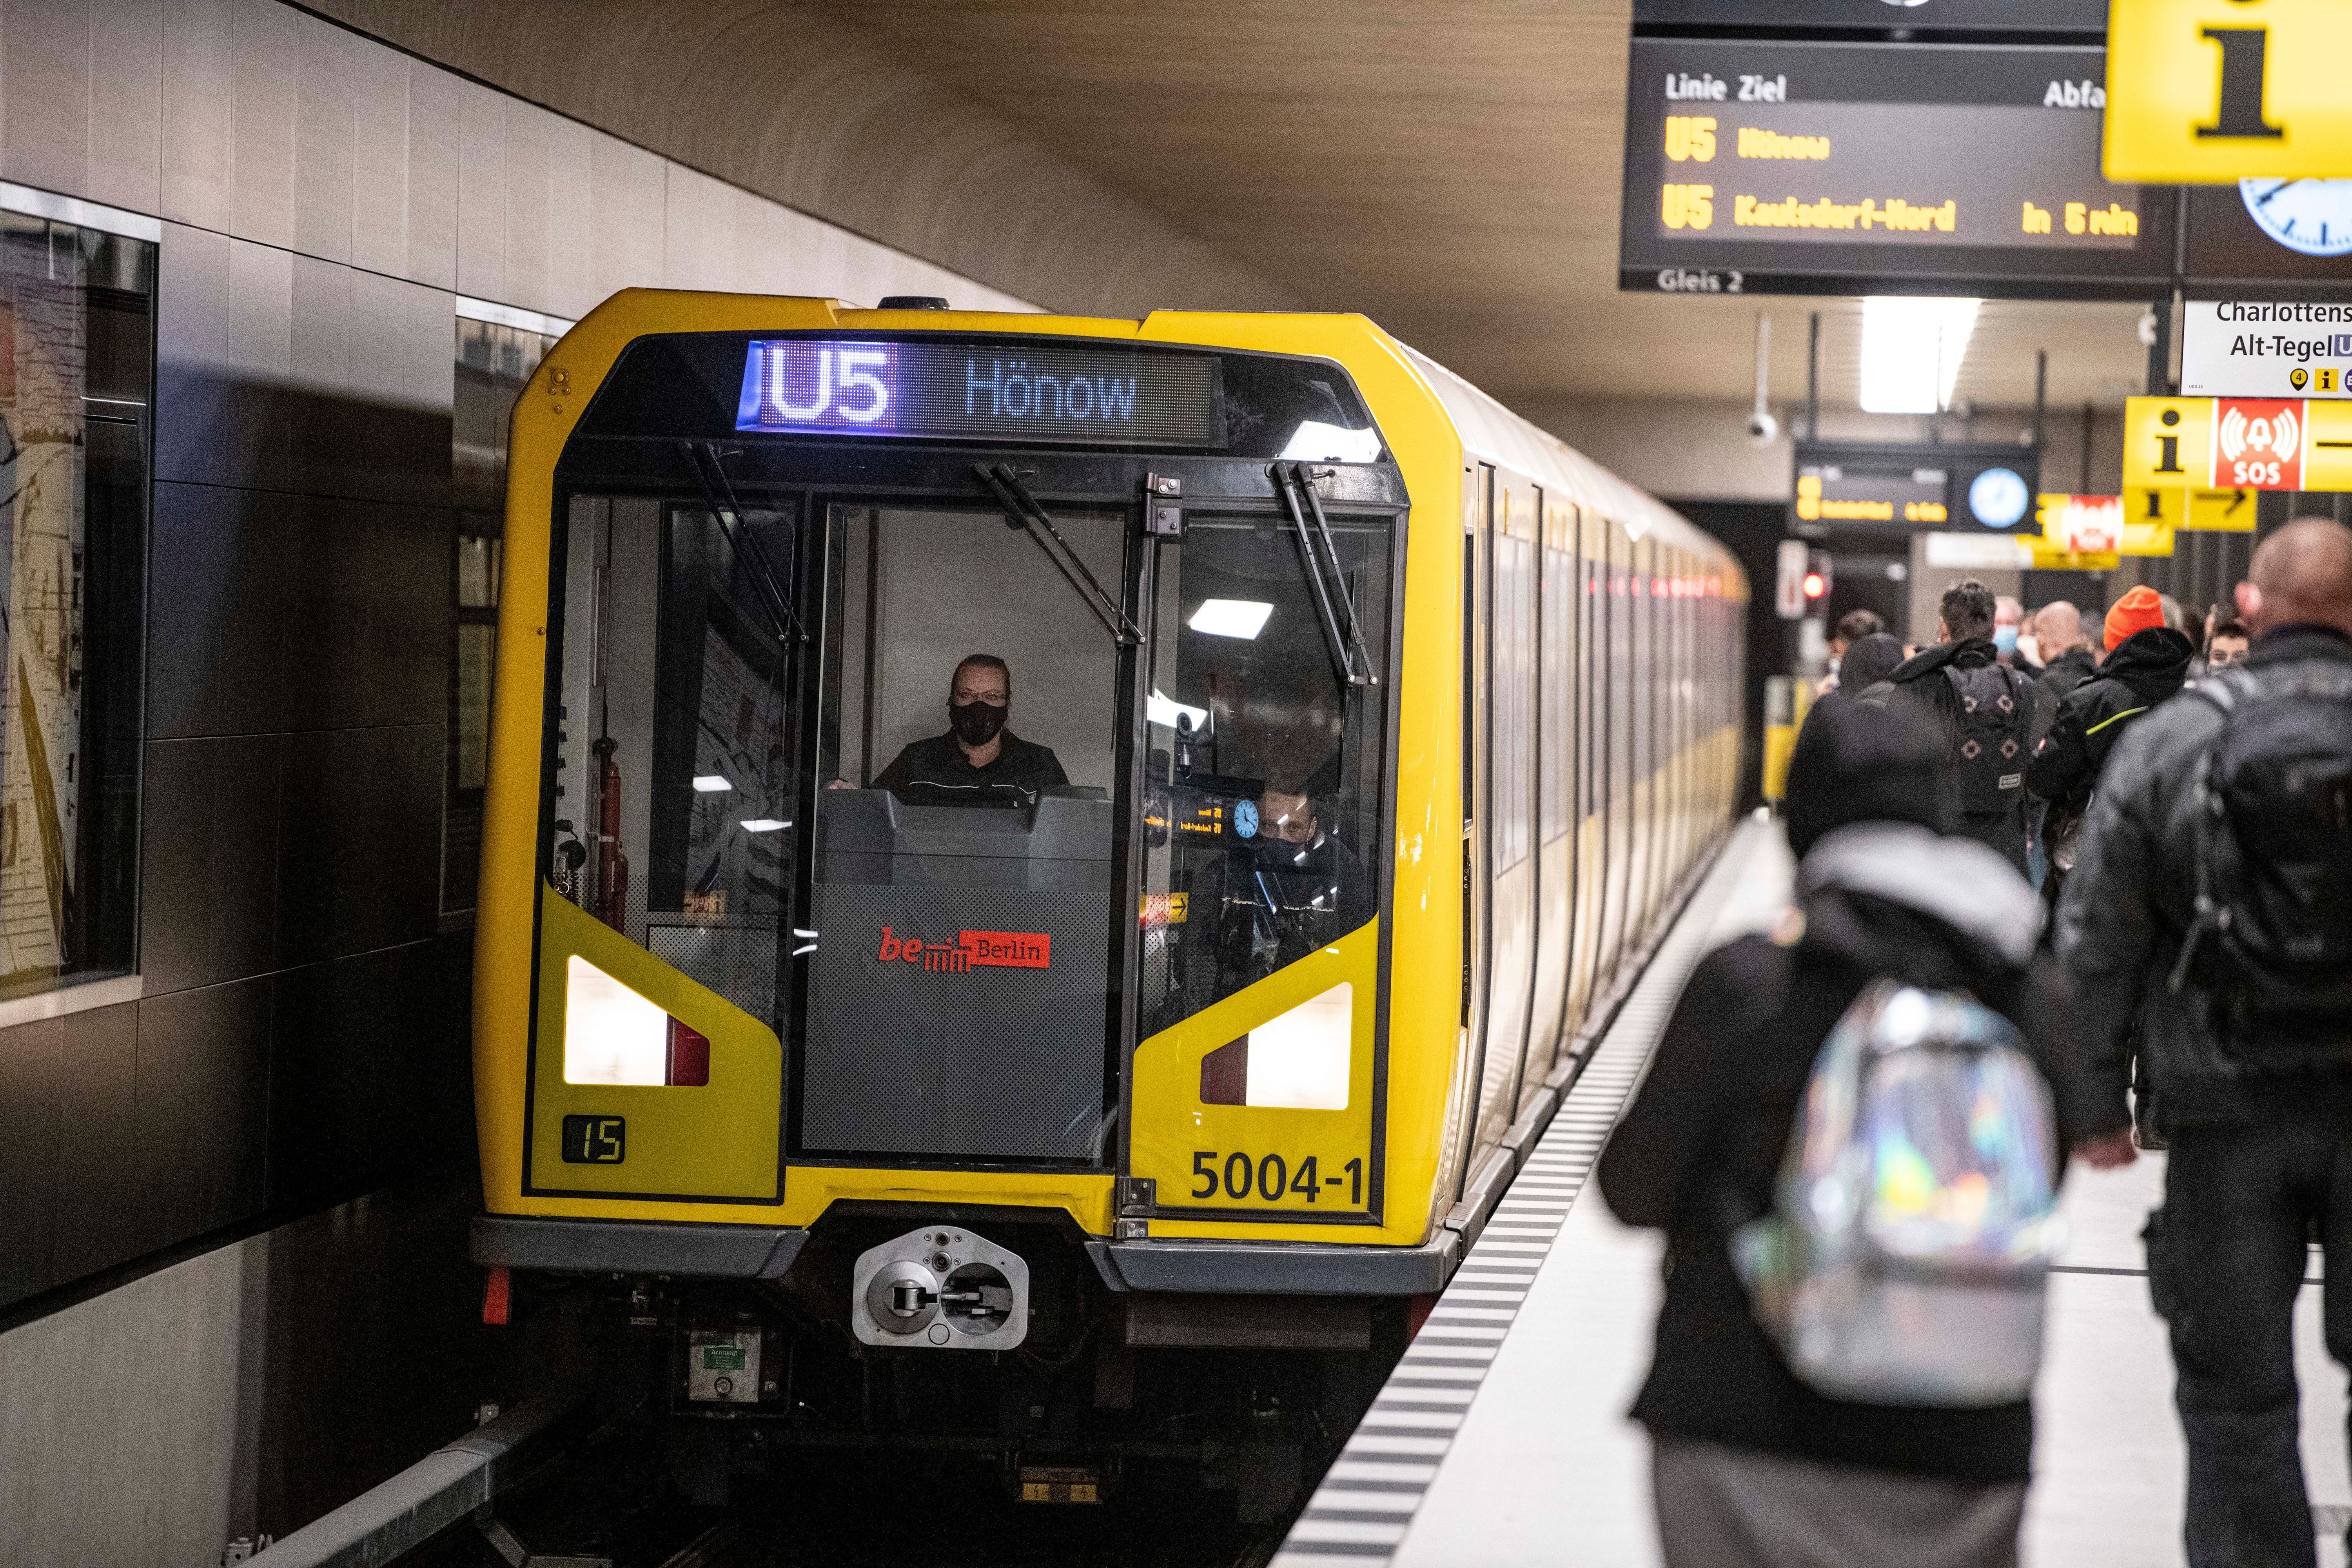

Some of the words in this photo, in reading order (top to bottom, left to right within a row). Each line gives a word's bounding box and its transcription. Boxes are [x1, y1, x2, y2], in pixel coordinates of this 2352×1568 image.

[1665, 73, 1728, 101] Linie
[1737, 74, 1787, 102] Ziel
[1664, 116, 1717, 162] U5
[1661, 183, 1714, 230] U5
[1734, 195, 1956, 232] Kaulsdorf-Nord
[2022, 201, 2052, 234] in
[2064, 202, 2087, 235] 5
[2089, 203, 2139, 236] min
[1657, 269, 1721, 292] Gleis
[1728, 270, 1744, 293] 2
[2230, 334, 2332, 362] Alt-Tegel
[771, 349, 888, 421] U5
[966, 359, 1136, 420] Hönow
[2234, 461, 2281, 485] SOS
[879, 927, 922, 962] be
[976, 940, 1040, 960] Berlin
[583, 1120, 621, 1160] 15
[1191, 1151, 1362, 1204] 5004-1
